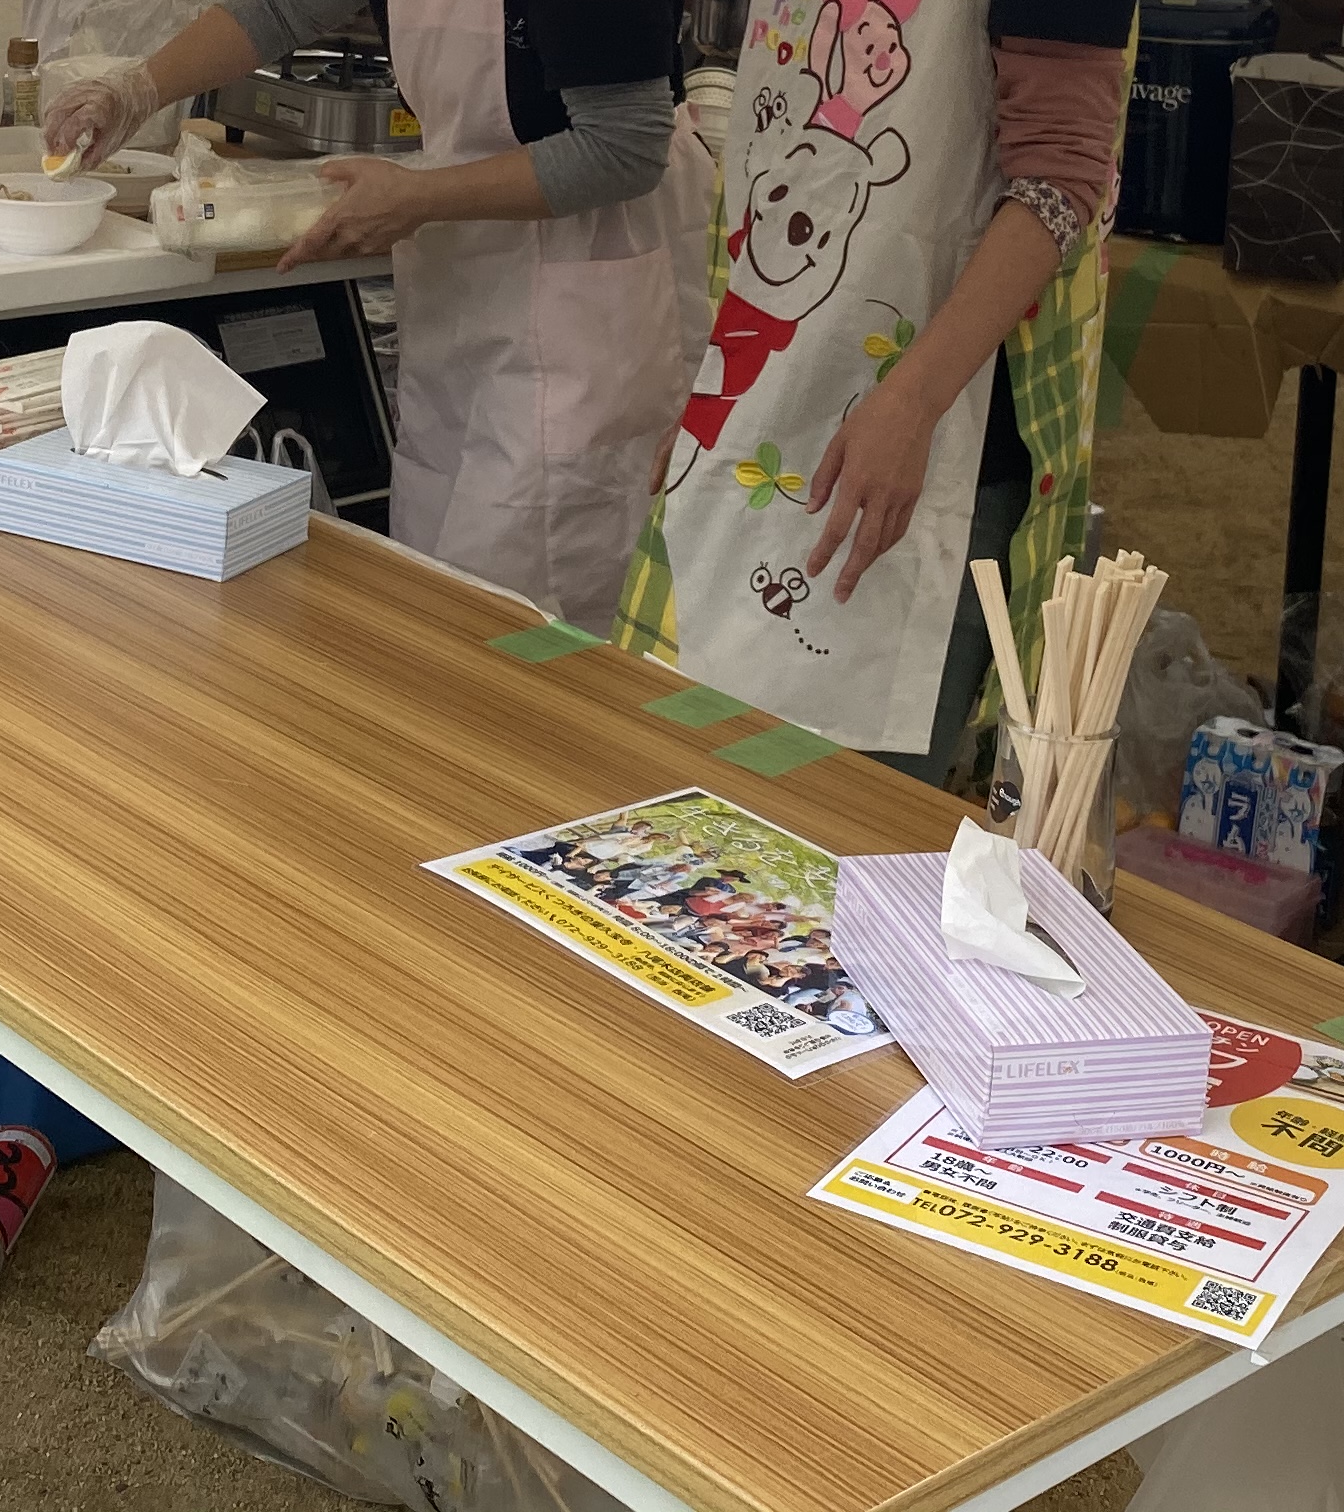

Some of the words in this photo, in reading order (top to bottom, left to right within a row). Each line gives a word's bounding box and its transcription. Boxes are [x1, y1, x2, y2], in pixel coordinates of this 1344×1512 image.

[672, 806, 838, 890] 生きるを支
[1207, 1021, 1271, 1046] OPEN
[1006, 1060, 1080, 1079] LIFELEX
[848, 1174, 907, 1198] お問い合わせ
[918, 1158, 998, 1191] 男女不問
[1157, 1183, 1238, 1216] シフト制
[1106, 1218, 1189, 1253] 制服貸与
[1114, 1208, 1218, 1250] 交通費支給
